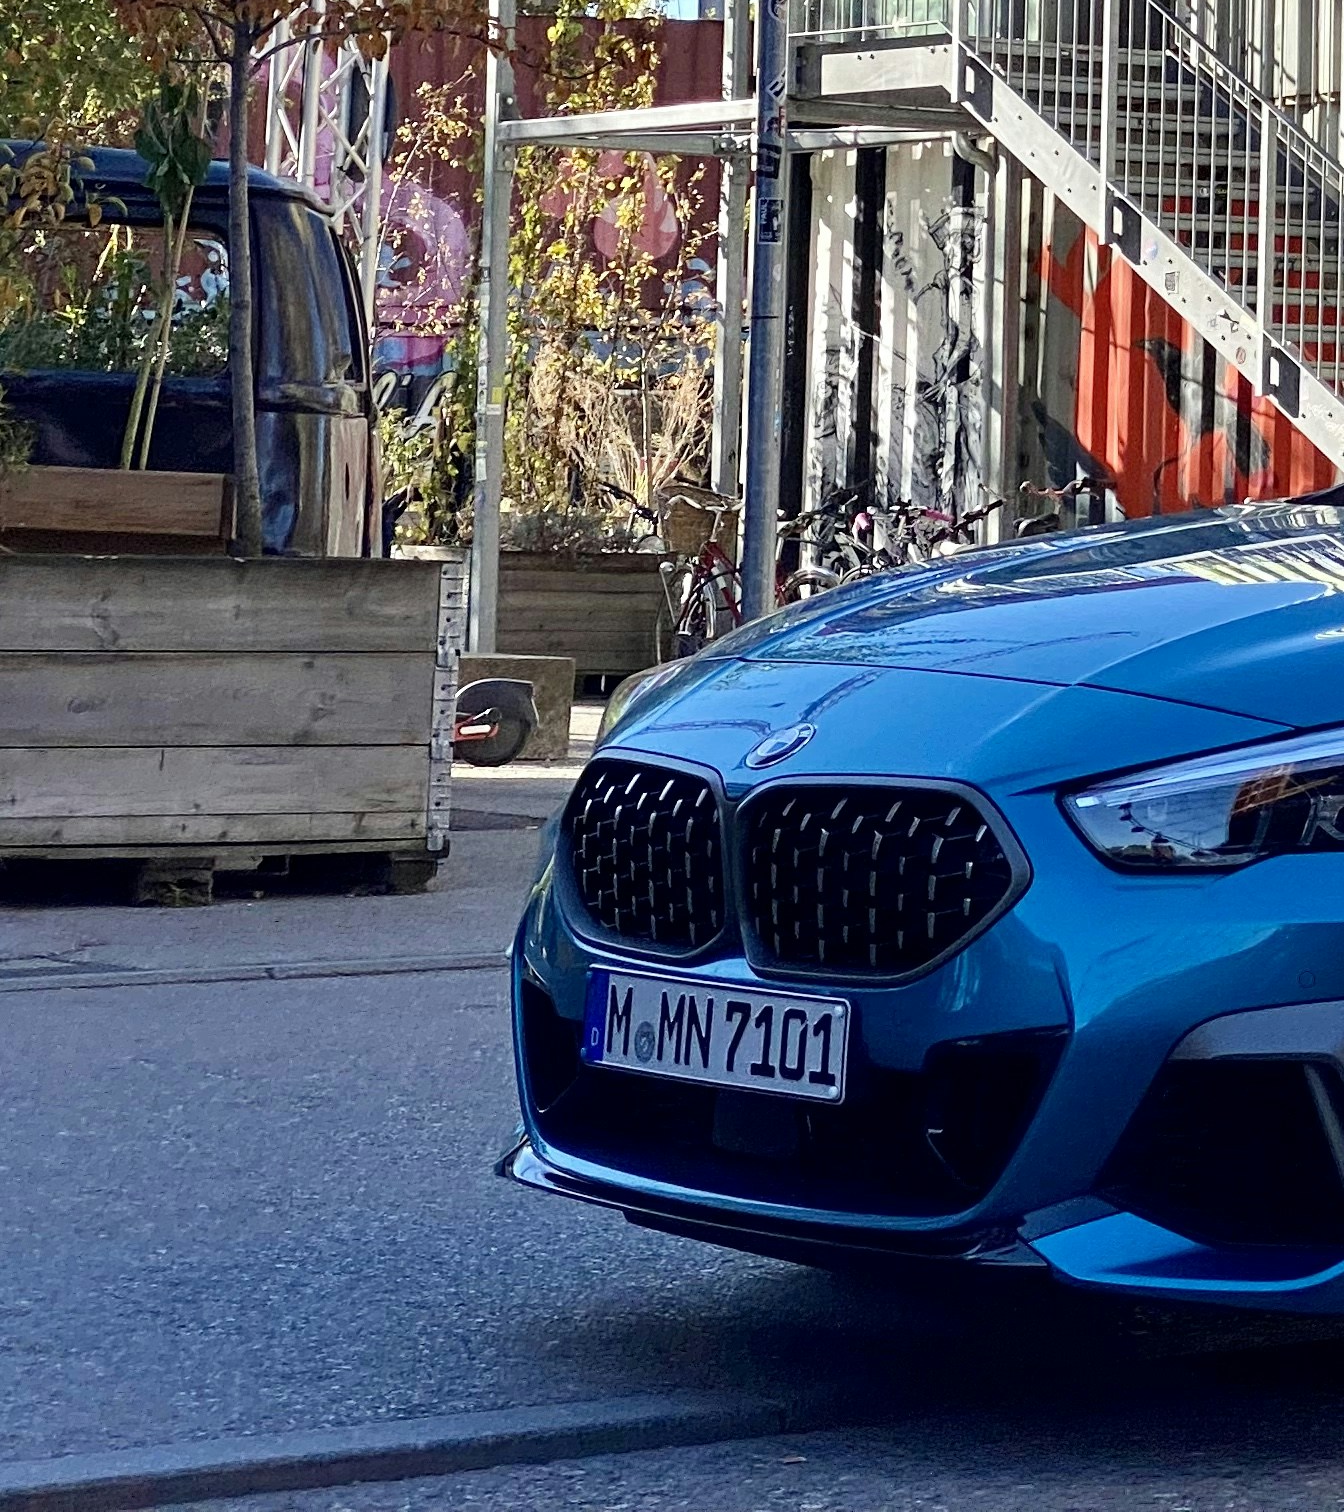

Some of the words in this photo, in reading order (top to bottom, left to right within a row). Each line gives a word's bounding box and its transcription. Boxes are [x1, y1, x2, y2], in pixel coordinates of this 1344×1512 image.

[606, 983, 634, 1057] M
[656, 989, 714, 1069] MN
[725, 999, 837, 1086] 7101
